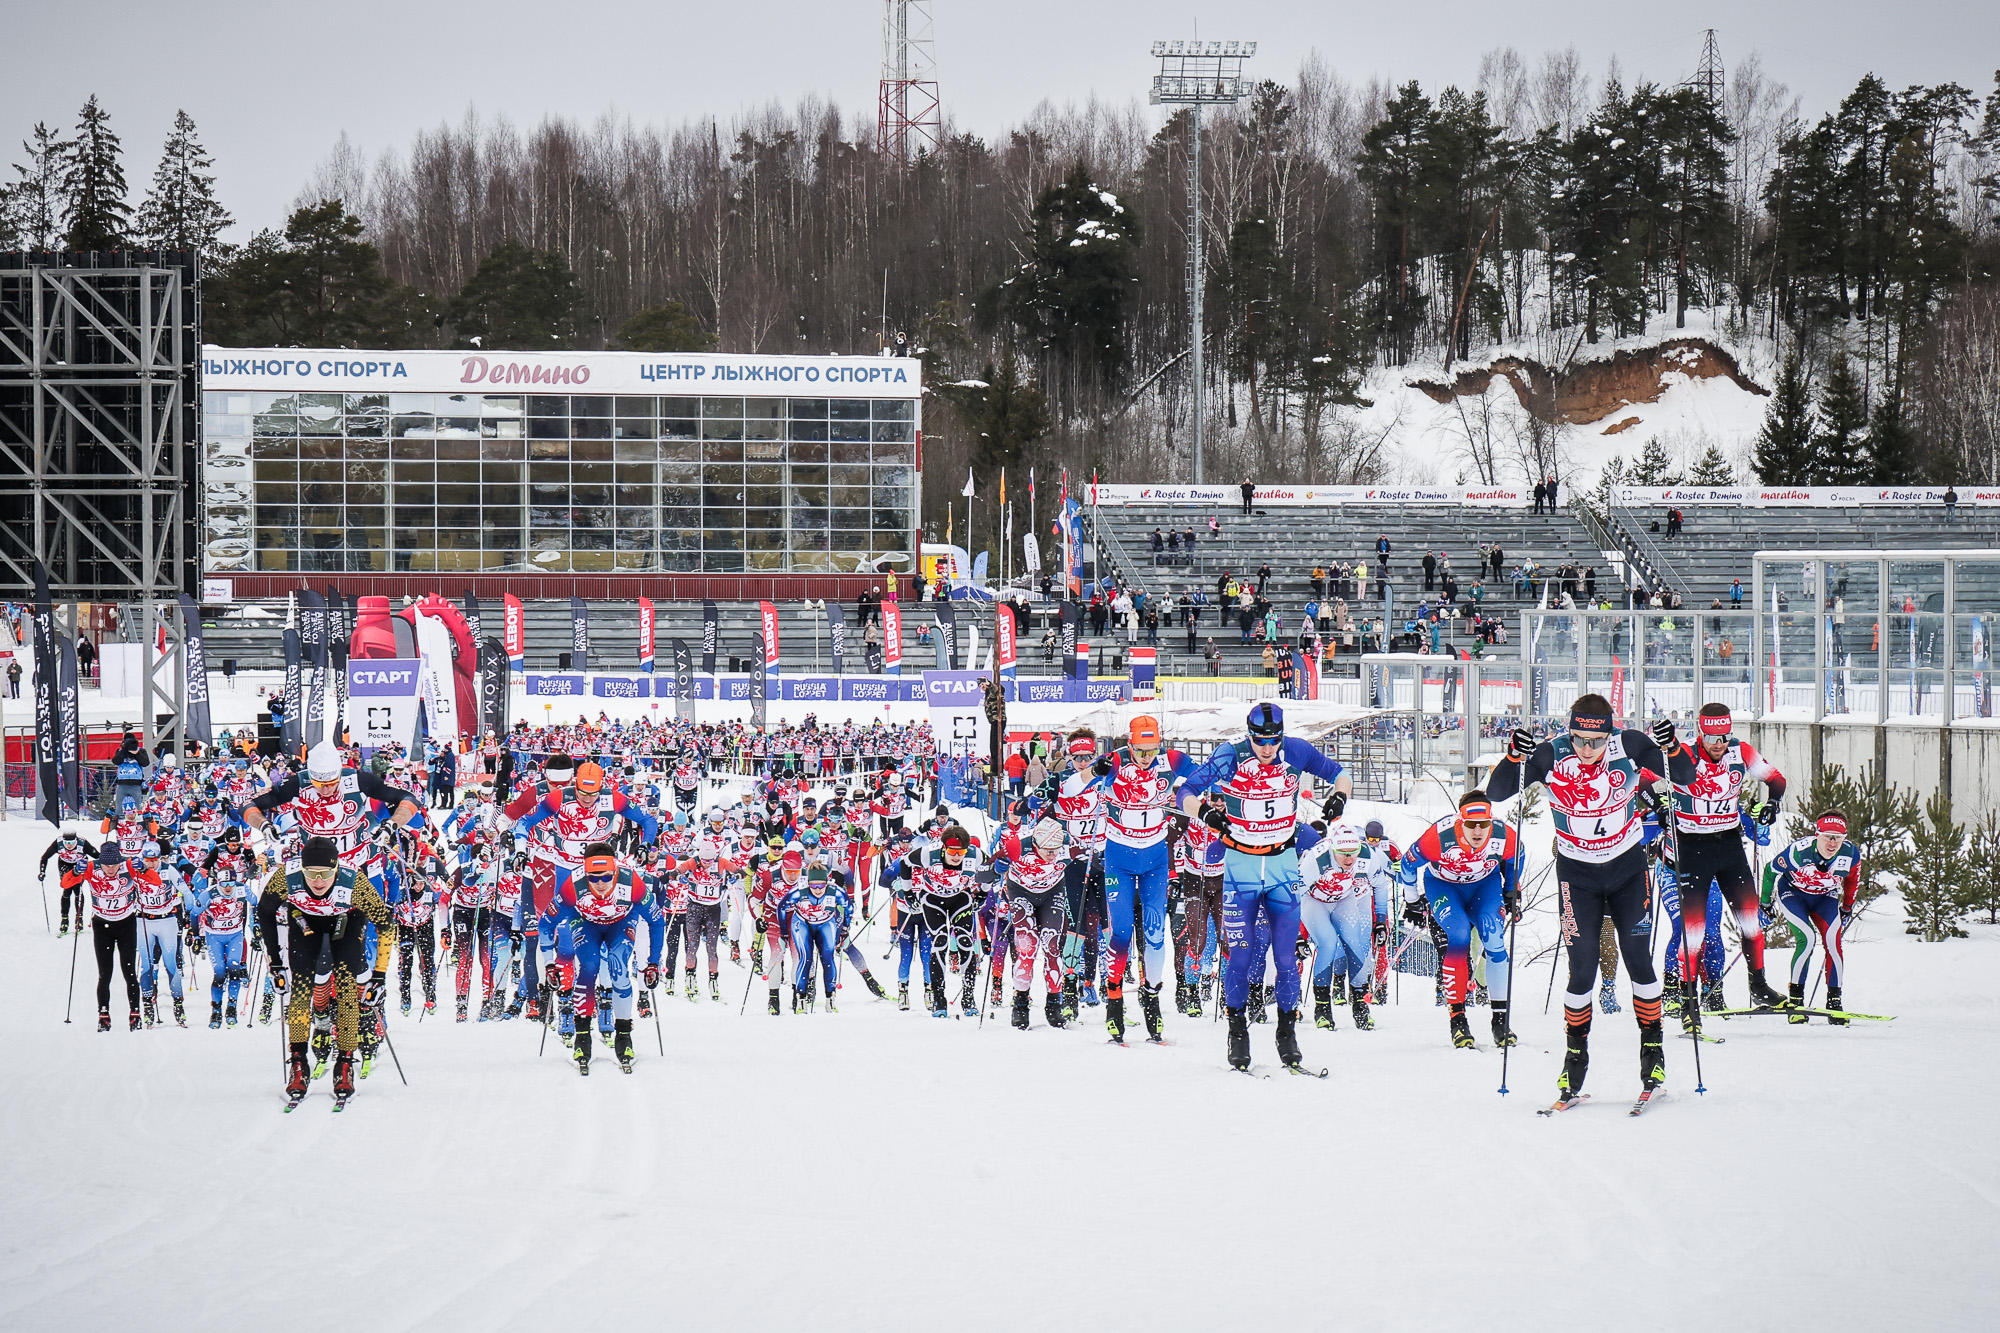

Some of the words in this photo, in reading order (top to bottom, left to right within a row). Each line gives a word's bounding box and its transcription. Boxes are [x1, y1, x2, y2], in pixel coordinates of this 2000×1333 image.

[318, 360, 408, 378] СПОРТА
[461, 356, 591, 385] Демино
[640, 364, 706, 382] ЦЕНТР
[711, 365, 820, 382] ЛЫЖНОГО
[825, 367, 908, 383] СПОРТА
[1154, 490, 1186, 499] Rostec
[1190, 490, 1224, 499] Demino
[1252, 489, 1294, 499] arathon
[1379, 490, 1410, 500] Rostec
[1414, 490, 1448, 500] Demino
[1466, 489, 1517, 500] marathon
[1675, 490, 1705, 500] Rostec
[1709, 491, 1742, 501] Demino
[1761, 490, 1810, 500] marathon
[1892, 491, 1922, 500] Rostec
[352, 670, 412, 684] СТАРТ
[538, 680, 572, 688] RUSSIA
[604, 681, 639, 690] RUSSIA
[793, 683, 827, 691] RUSSIA
[852, 683, 887, 692] RUSSIA
[929, 679, 984, 694] СТАР
[1030, 684, 1064, 693] RUSSIA
[1086, 684, 1121, 693] RUSSIA
[538, 687, 572, 695] LOPPET
[604, 689, 639, 697] LOPPET
[793, 690, 827, 699] LOPPET
[852, 691, 887, 699] LOPPET
[1030, 692, 1064, 700] LOPPET
[1086, 692, 1121, 700] LOPPET
[1575, 716, 1605, 724] ROMANOV
[455, 773, 478, 781] ТАРТ
[1264, 799, 1275, 819] 5
[1703, 800, 1730, 814] 124
[1141, 811, 1147, 827] 1
[1080, 820, 1095, 835] 22
[1248, 819, 1290, 831] Демино
[1593, 818, 1606, 836] 4
[125, 841, 136, 849] 89
[1578, 834, 1624, 850] Демино
[704, 886, 714, 896] 13
[105, 899, 119, 909] 72
[144, 896, 161, 905] 130
[1560, 881, 1581, 937] ROMANOV
